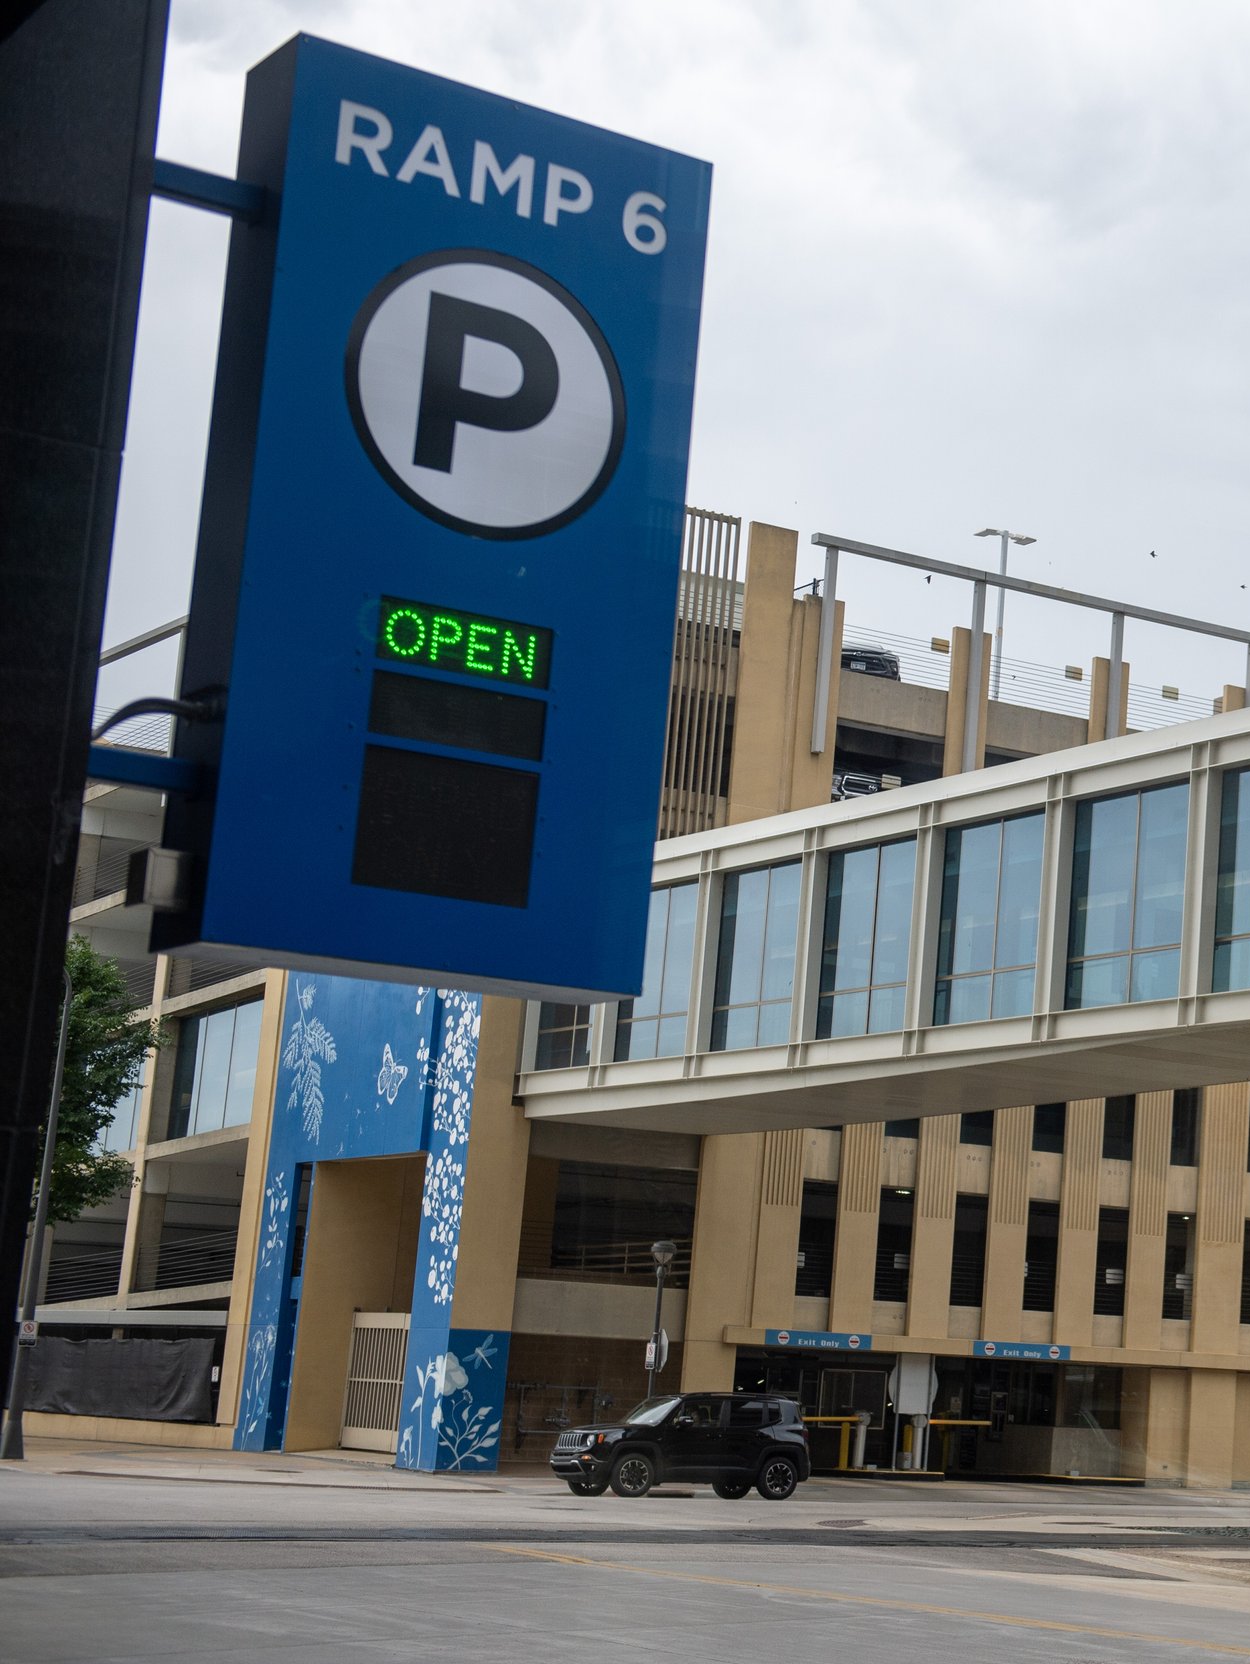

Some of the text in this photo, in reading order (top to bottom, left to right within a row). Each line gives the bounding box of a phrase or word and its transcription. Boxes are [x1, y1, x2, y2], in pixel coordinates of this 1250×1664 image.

[335, 99, 668, 256] RAMP 6
[413, 290, 560, 474] P
[386, 609, 537, 680] OPEN
[820, 1340, 840, 1348] Only
[1003, 1349, 1042, 1358] Exit Only
